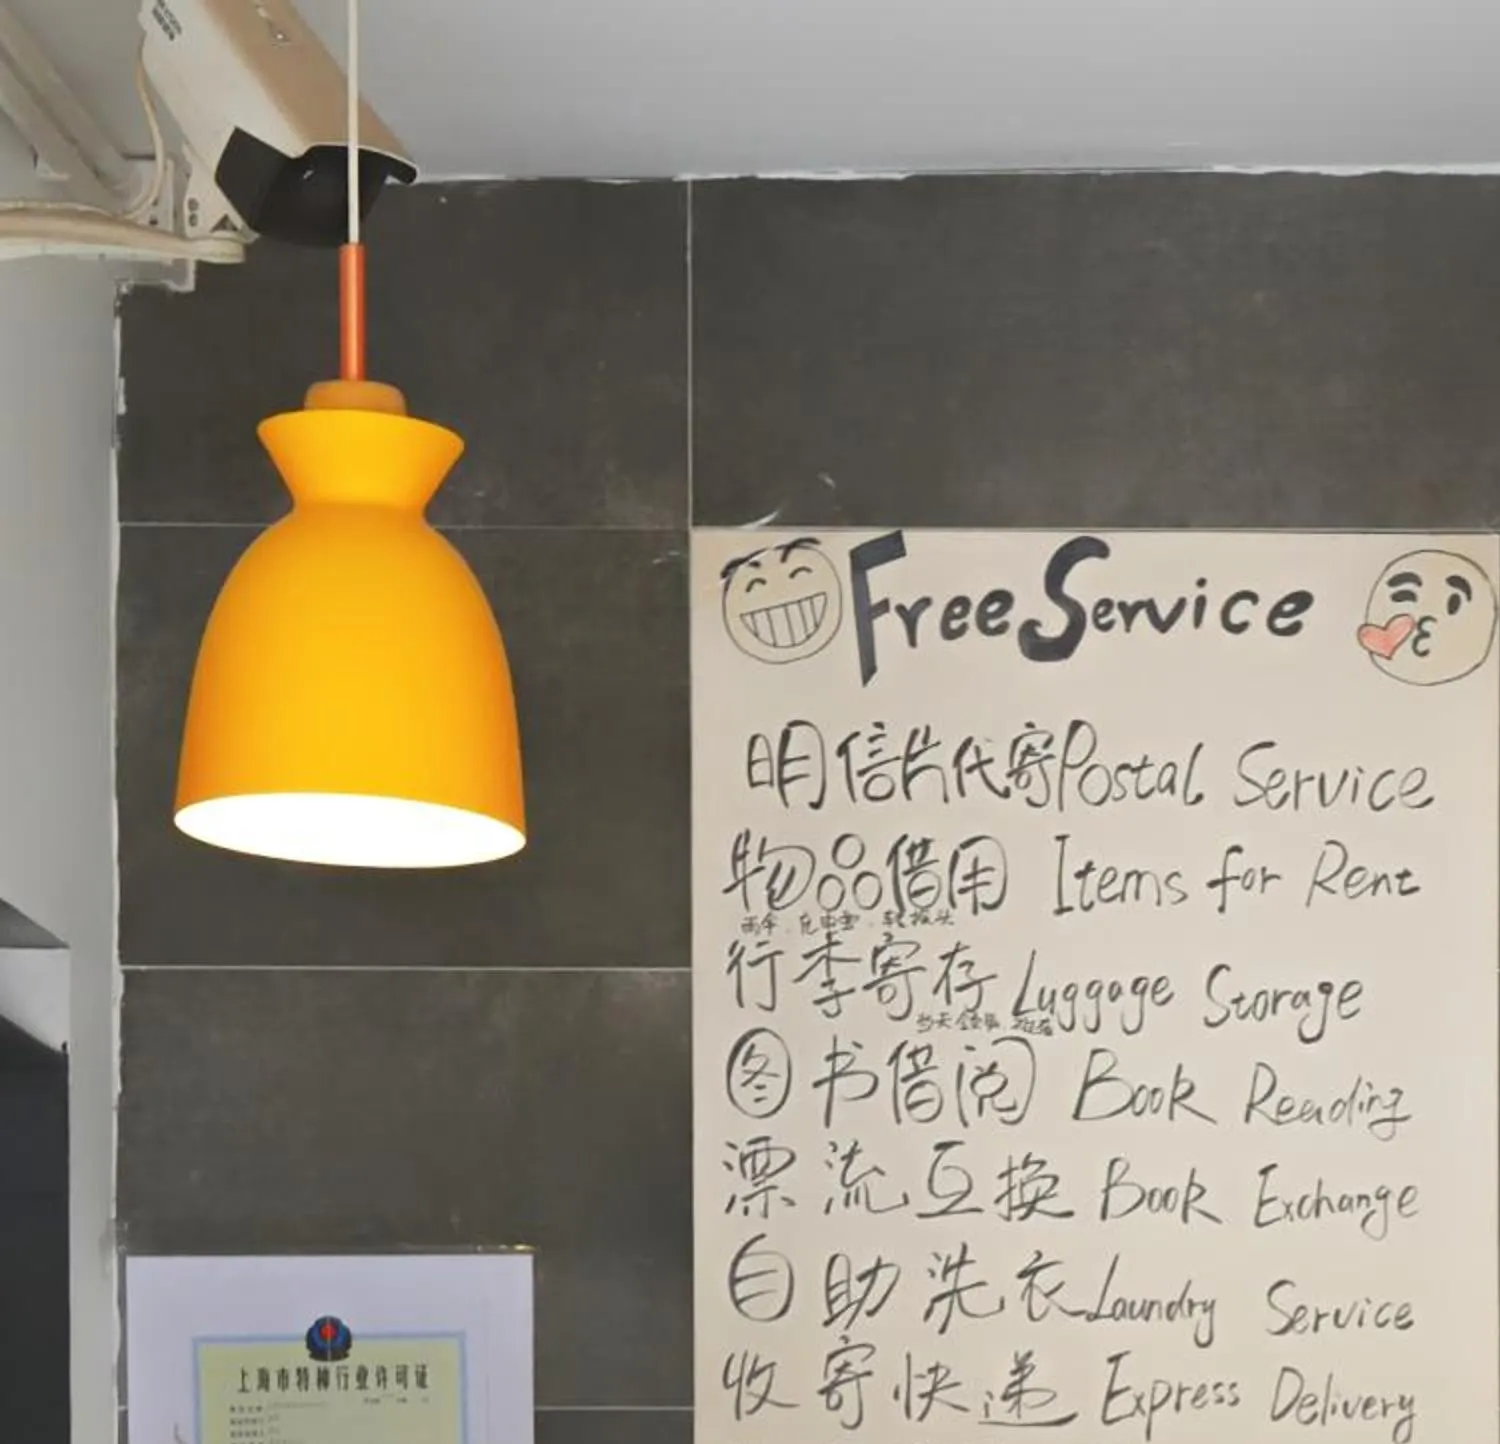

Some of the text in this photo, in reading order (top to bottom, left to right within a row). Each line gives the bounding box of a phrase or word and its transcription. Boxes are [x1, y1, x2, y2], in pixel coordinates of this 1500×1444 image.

[848, 529, 1316, 688] Free Service
[747, 718, 1056, 809] 明信片代寄
[1057, 719, 1436, 813] Postal Service
[722, 828, 1008, 915] 物品借用
[1047, 832, 1422, 916] Items for Rent
[726, 931, 999, 1021] 行李寄存
[1011, 949, 1365, 1045] Luggage Storage
[726, 1027, 1037, 1128] 图书借阅
[1072, 1047, 1412, 1142] Book Reading
[723, 1136, 1075, 1221] 漂流互换
[1101, 1156, 1420, 1241] Book Exchange
[728, 1233, 1084, 1335] 自助洗衣
[1084, 1254, 1416, 1348] Laundry Service
[722, 1334, 1079, 1429] 收寄快递
[1101, 1352, 1418, 1444] Express Delivery
